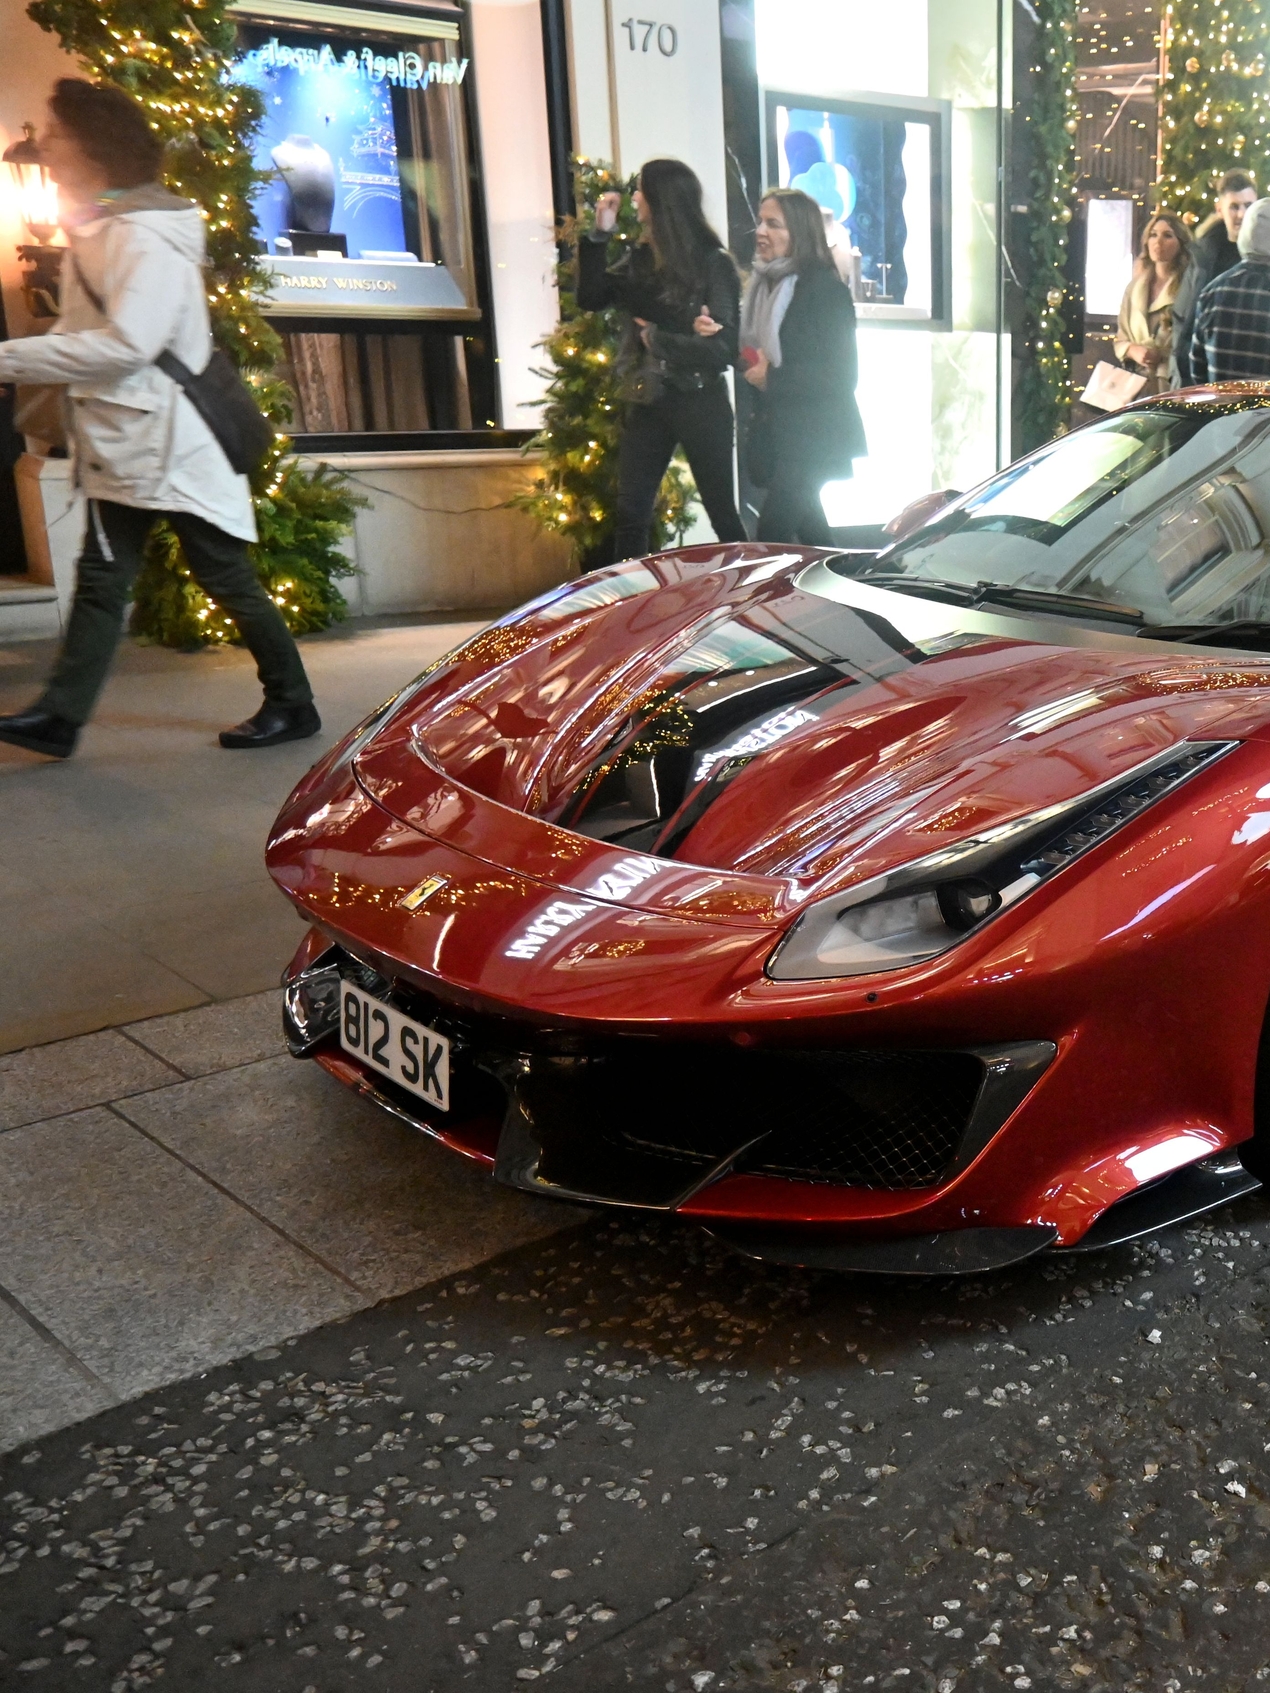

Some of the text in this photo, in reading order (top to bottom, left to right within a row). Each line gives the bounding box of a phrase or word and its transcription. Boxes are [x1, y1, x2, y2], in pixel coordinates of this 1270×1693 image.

[621, 17, 678, 57] 170
[281, 275, 397, 292] HARRY WINSTON
[344, 991, 444, 1102] 812 SK
